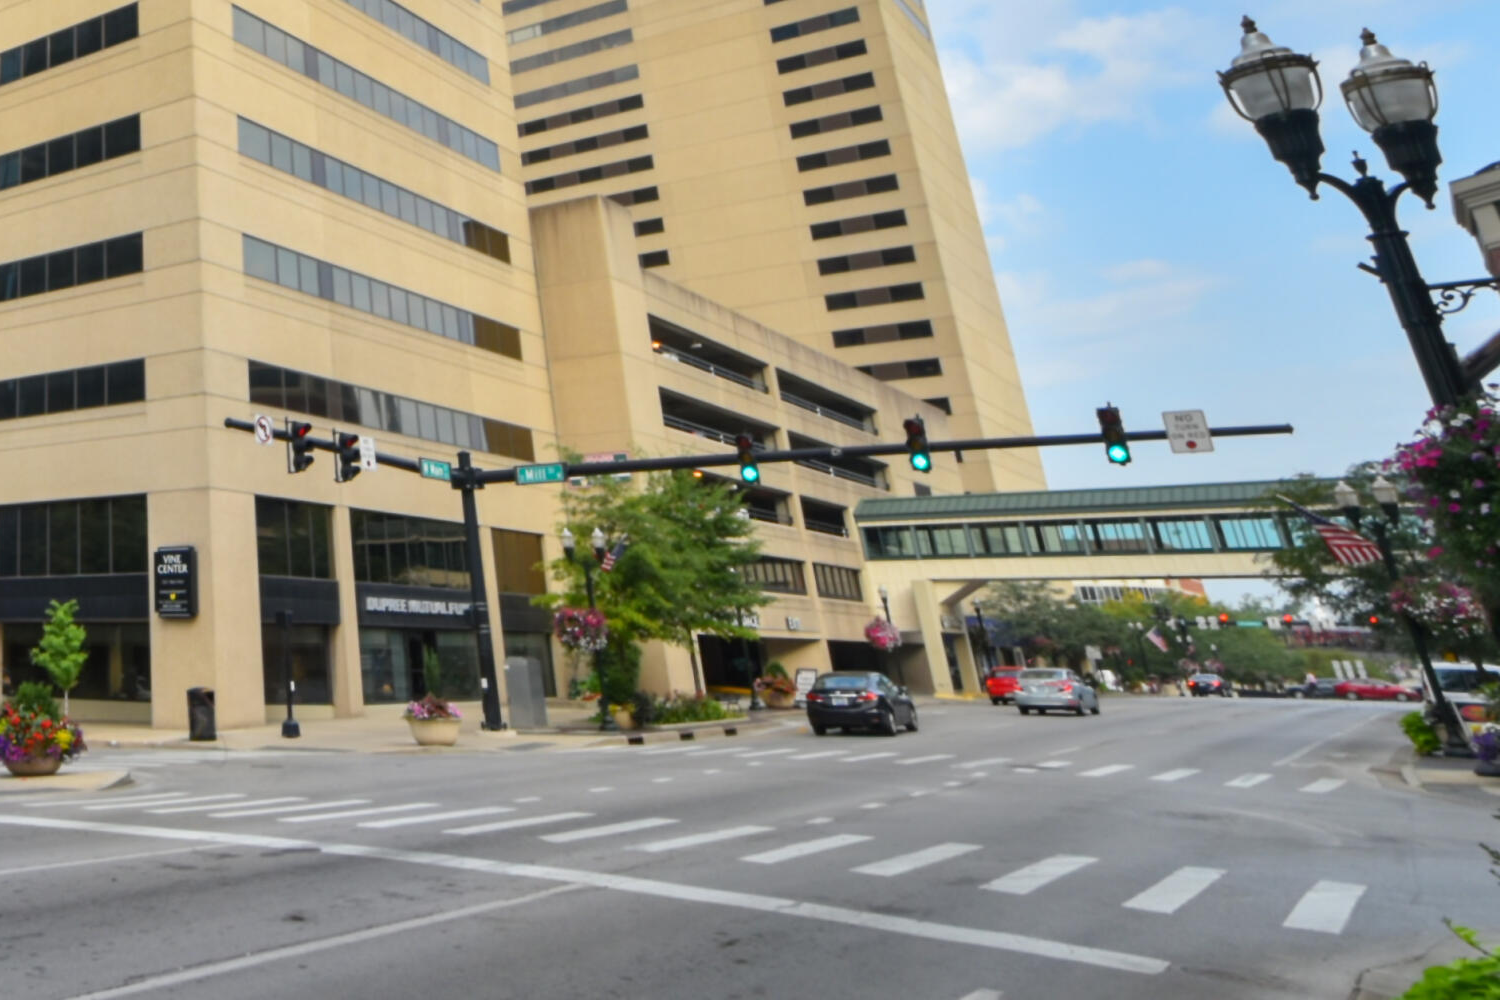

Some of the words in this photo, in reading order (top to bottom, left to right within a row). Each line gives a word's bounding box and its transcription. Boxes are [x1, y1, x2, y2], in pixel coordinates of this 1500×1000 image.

[1174, 413, 1193, 423] NO
[525, 468, 546, 481] Mill
[162, 554, 182, 564] VINE
[157, 563, 188, 575] CENTER
[365, 596, 408, 612] DUPREE
[408, 599, 449, 615] MUTUAL
